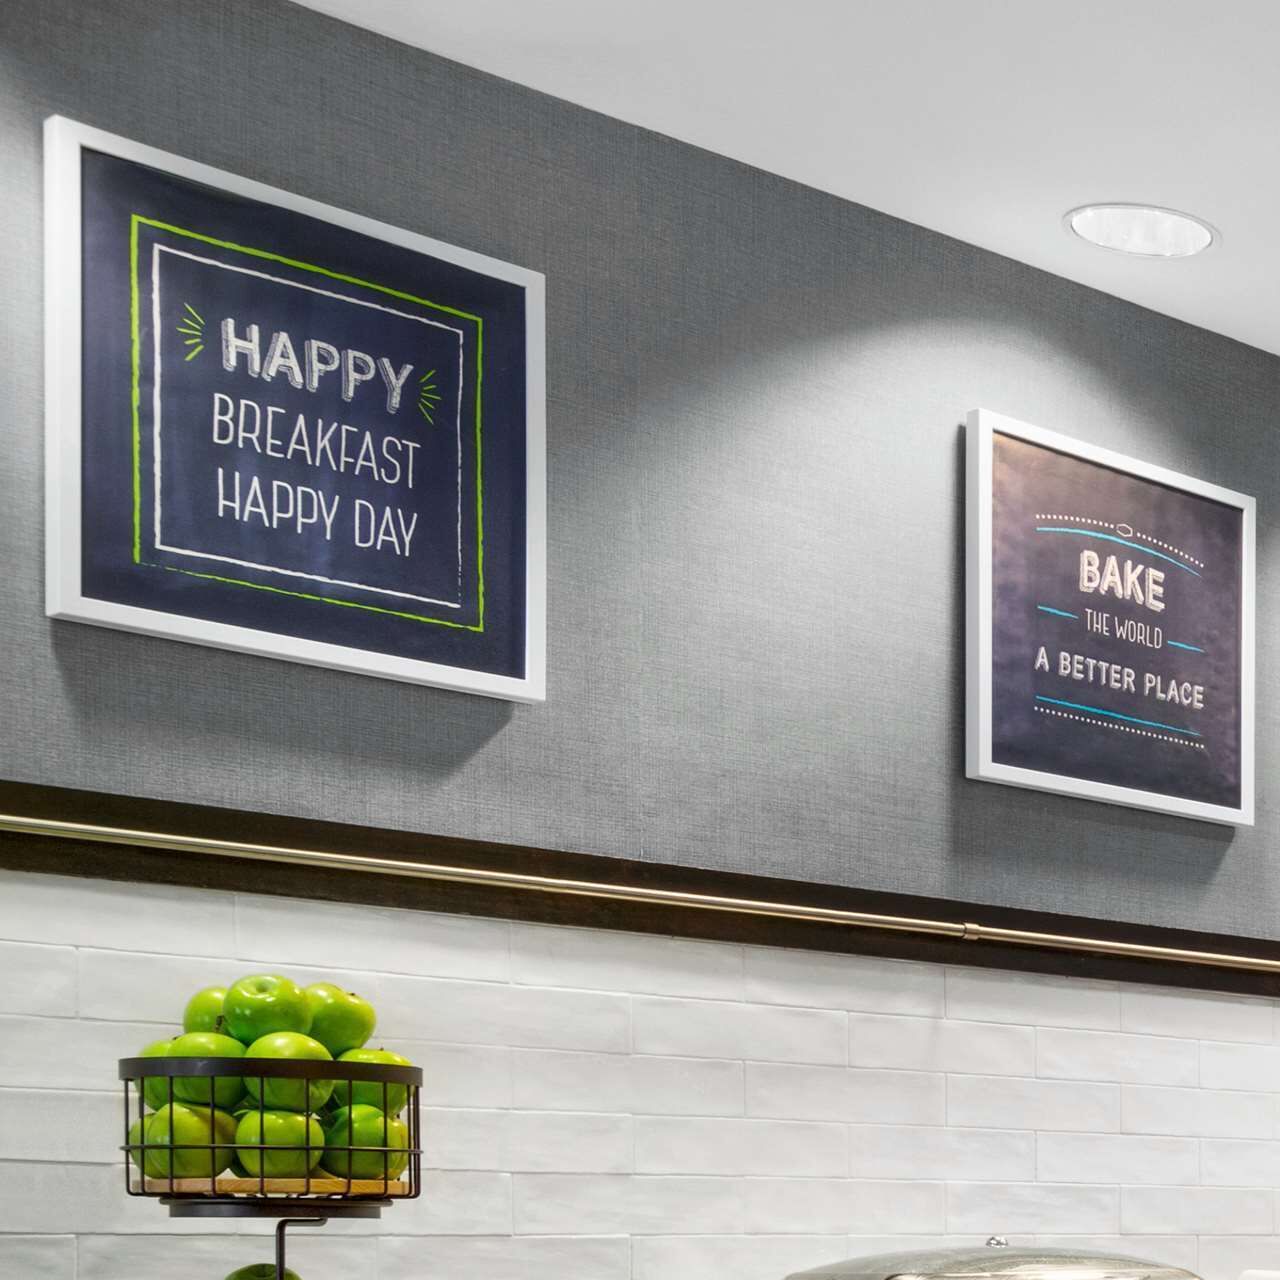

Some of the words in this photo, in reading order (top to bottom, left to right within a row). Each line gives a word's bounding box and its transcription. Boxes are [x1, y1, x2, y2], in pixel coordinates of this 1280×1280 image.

[221, 318, 414, 414] HAPPY
[213, 393, 421, 488] BREAKFAST
[217, 467, 340, 540] HAPPY
[355, 499, 418, 556] DAY
[1079, 550, 1166, 612] BAKE
[1085, 608, 1110, 636] THE
[1114, 616, 1163, 649] WORLD
[1034, 646, 1050, 673] A
[1058, 651, 1136, 693] BETTER
[1143, 673, 1204, 710] PLACE
